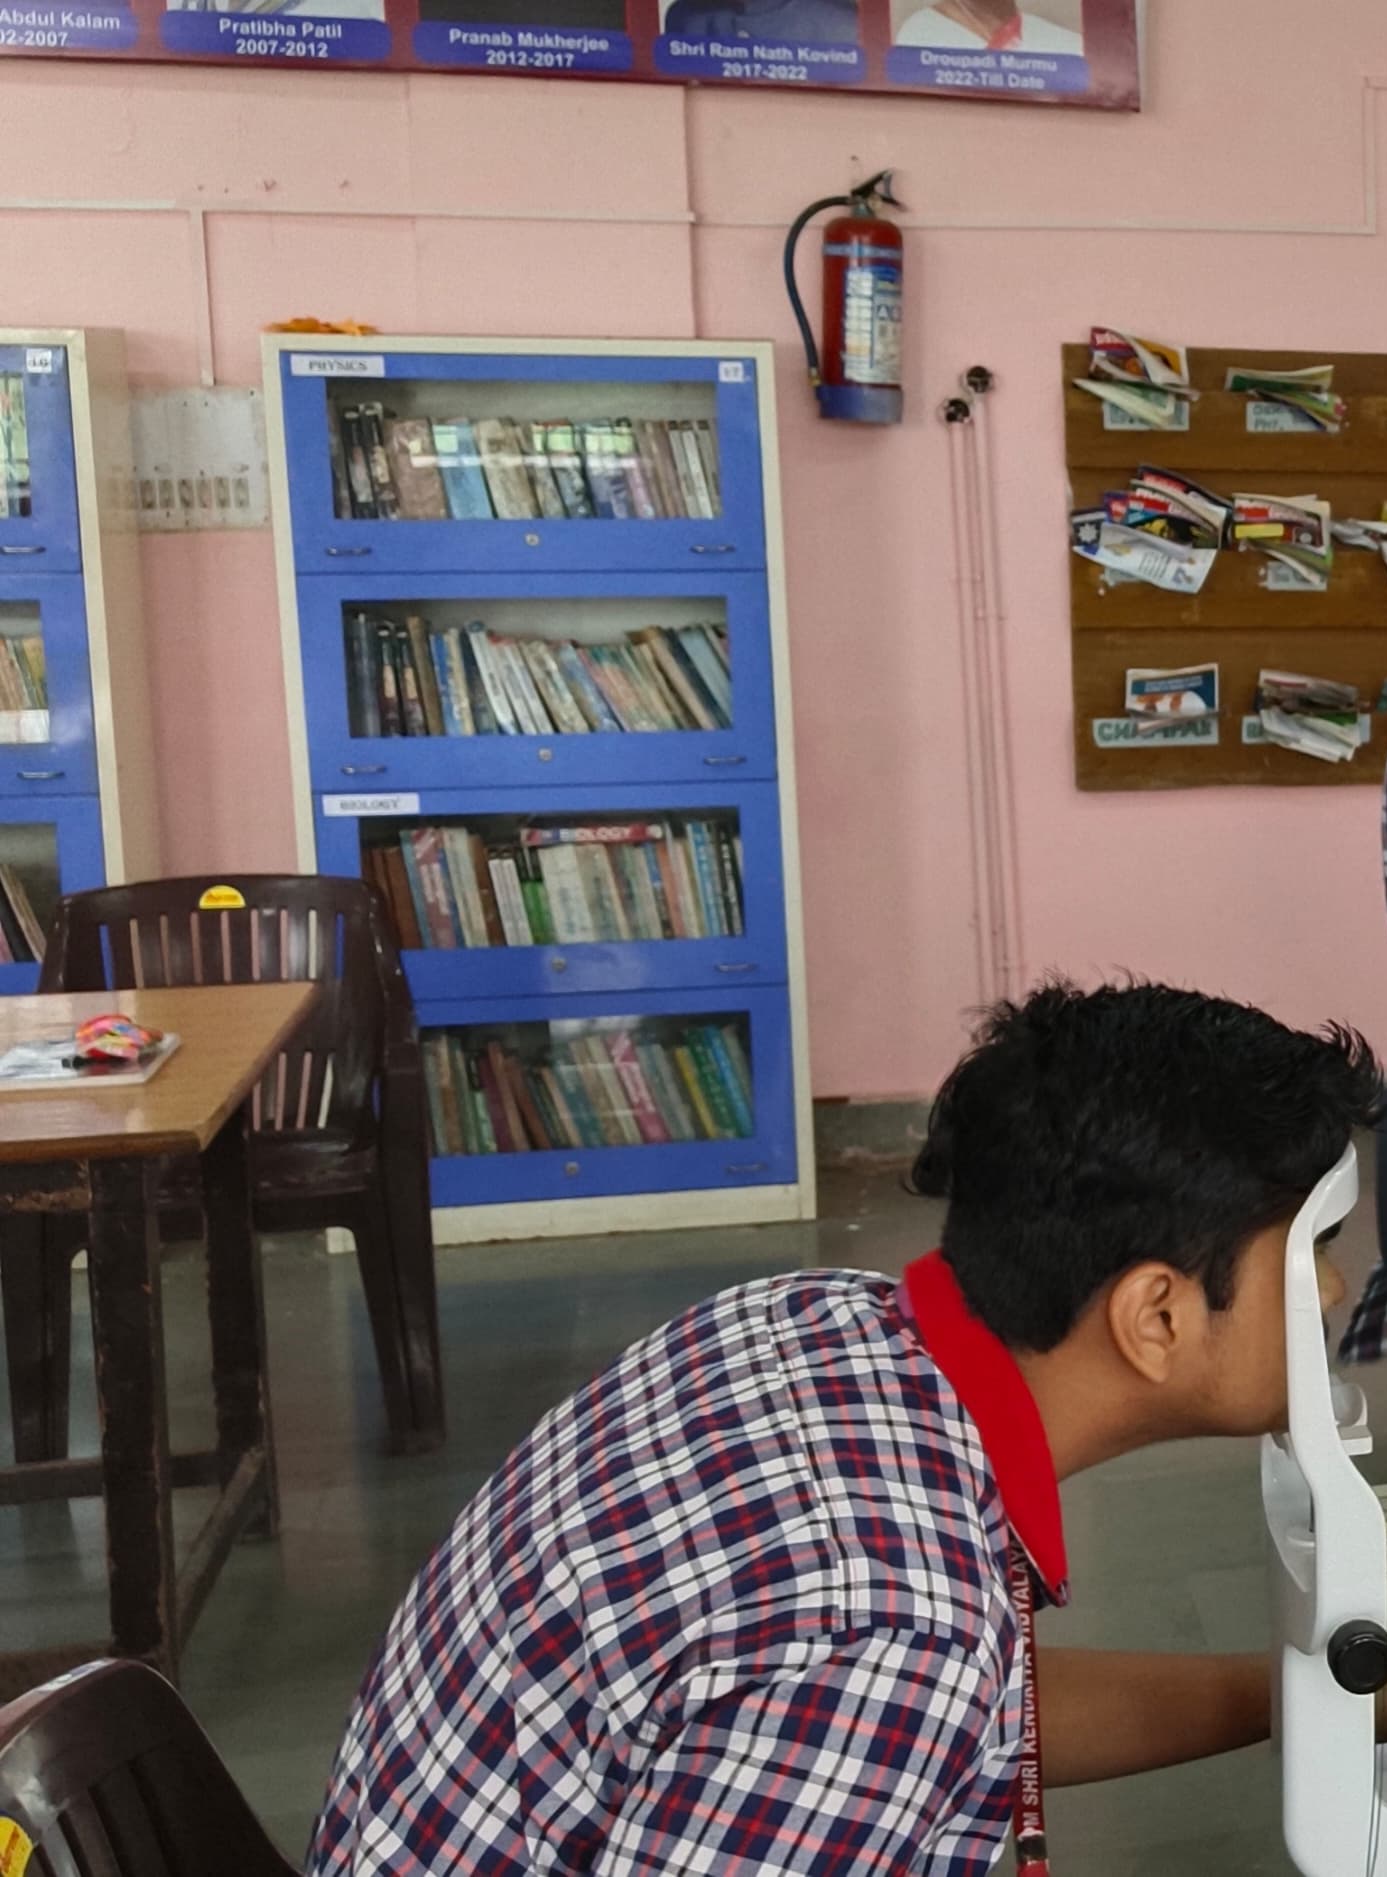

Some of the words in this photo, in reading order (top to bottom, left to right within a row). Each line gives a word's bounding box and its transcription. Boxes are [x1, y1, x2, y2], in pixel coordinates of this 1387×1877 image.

[61, 14, 121, 30] Kalam
[218, 18, 296, 37] Pratibha
[302, 23, 342, 39] Patil
[236, 39, 329, 58] 2007-2012
[450, 28, 513, 46] Pranab
[518, 33, 610, 51] Mukherjee
[486, 50, 575, 68] 2012-2017
[670, 40, 705, 56] Shri
[710, 42, 748, 58] Ram
[753, 44, 793, 60] Nath
[798, 47, 858, 65] Kovind
[920, 50, 996, 69] Droupadi
[1001, 55, 1058, 73] Murmu
[722, 62, 808, 80] 2017-2022
[935, 70, 1003, 88] 2022-Till
[1009, 74, 1046, 90] Date
[308, 360, 368, 371] PHYSICS
[340, 798, 399, 811] BIOLOGY
[1021, 1760, 1040, 1806] SHRI
